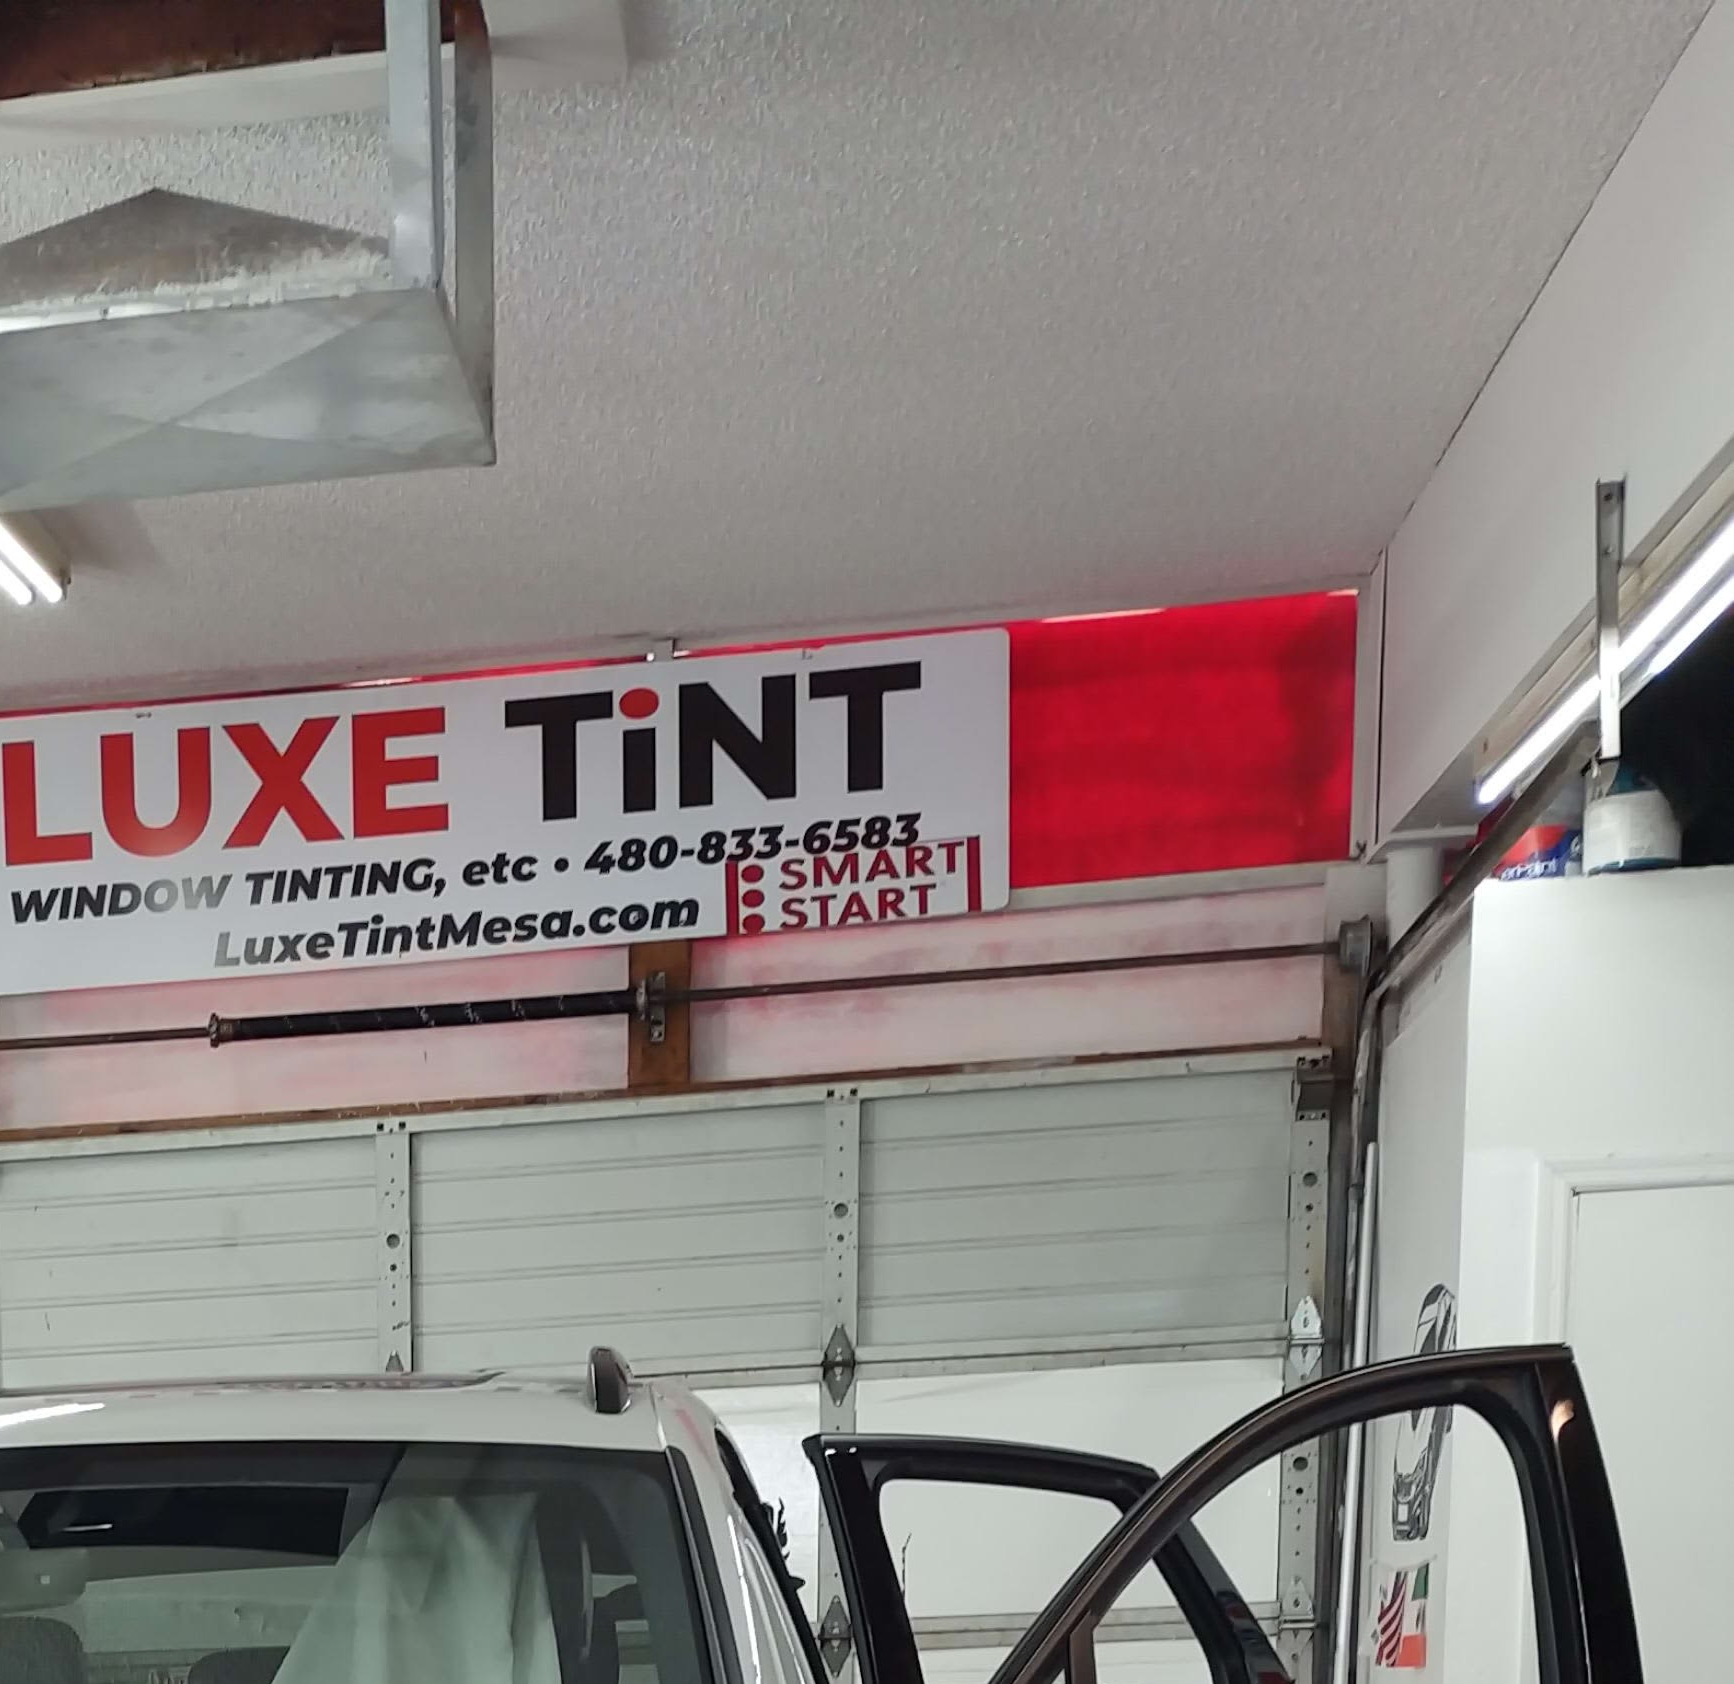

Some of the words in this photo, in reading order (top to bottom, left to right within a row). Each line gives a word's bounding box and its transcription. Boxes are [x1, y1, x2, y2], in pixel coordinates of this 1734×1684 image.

[1, 706, 449, 867] LUXE
[504, 660, 922, 822] TiNT
[10, 873, 233, 925] WINDOW
[245, 857, 447, 906] TINTING,
[462, 851, 538, 886] etc
[583, 812, 923, 877] 480-833-6583
[779, 840, 965, 891] SMART
[214, 897, 700, 969] LuxeTintMesa.com
[779, 883, 938, 931] START
